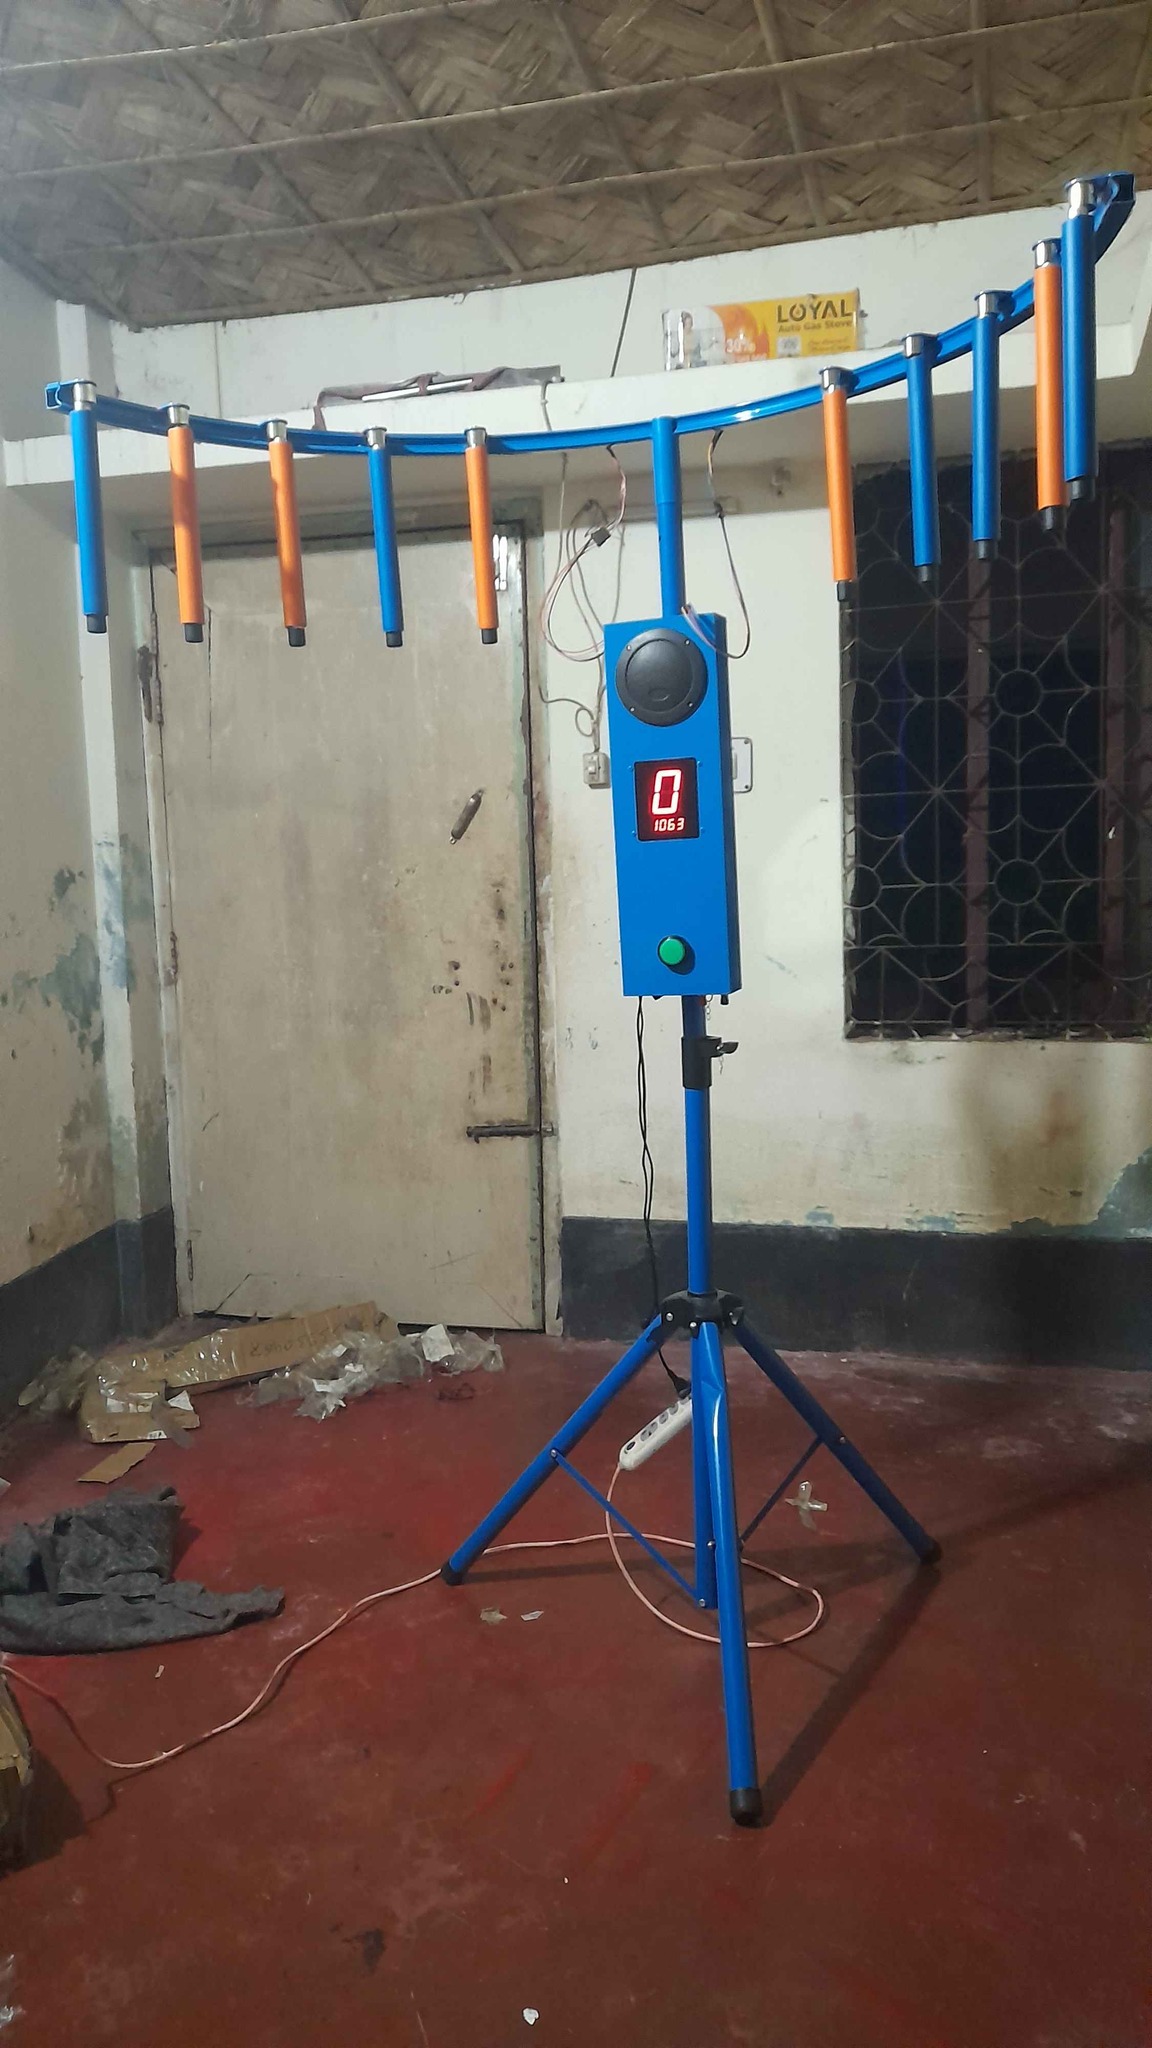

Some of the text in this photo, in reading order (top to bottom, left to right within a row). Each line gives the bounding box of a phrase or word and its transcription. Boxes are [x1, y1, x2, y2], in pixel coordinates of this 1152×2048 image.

[777, 299, 853, 323] LOYAL
[778, 319, 853, 333] Auto Gas Stove
[651, 769, 682, 815] 0
[654, 817, 685, 832] 1063
